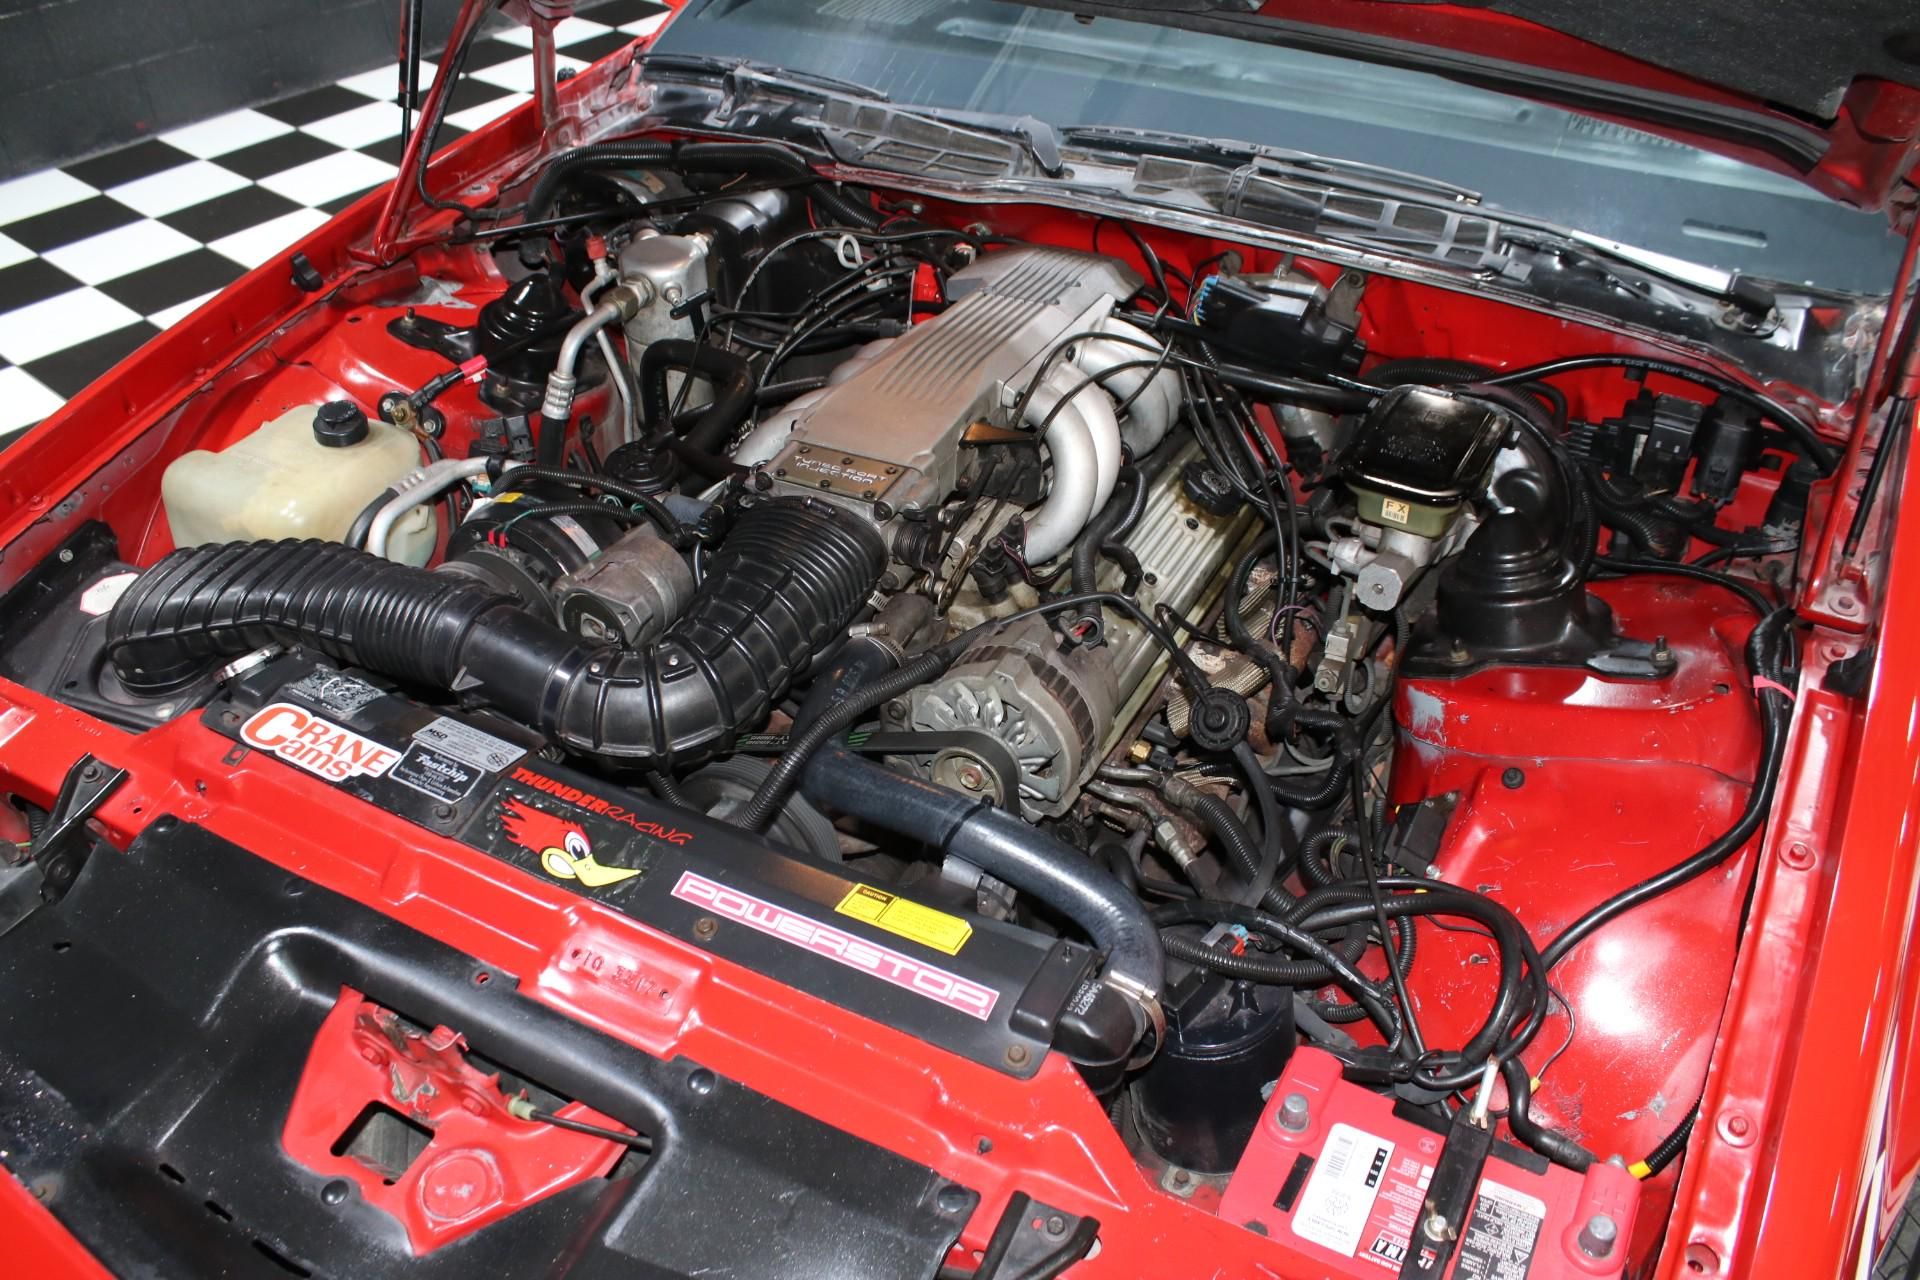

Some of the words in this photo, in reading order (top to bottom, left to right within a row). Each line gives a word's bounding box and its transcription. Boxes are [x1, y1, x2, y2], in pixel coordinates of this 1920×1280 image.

[1647, 361, 1680, 375] BATTERY
[794, 455, 842, 473] TUNED
[844, 468, 888, 482] PORT
[796, 462, 873, 485] INJECTION
[243, 706, 392, 774] CRANE
[425, 728, 448, 740] MSD
[416, 752, 470, 783] Fastchip
[510, 766, 608, 814] THUNDER
[602, 805, 694, 846] RACING
[862, 886, 889, 904] CAUTION
[680, 880, 990, 1010] POWERSTOP
